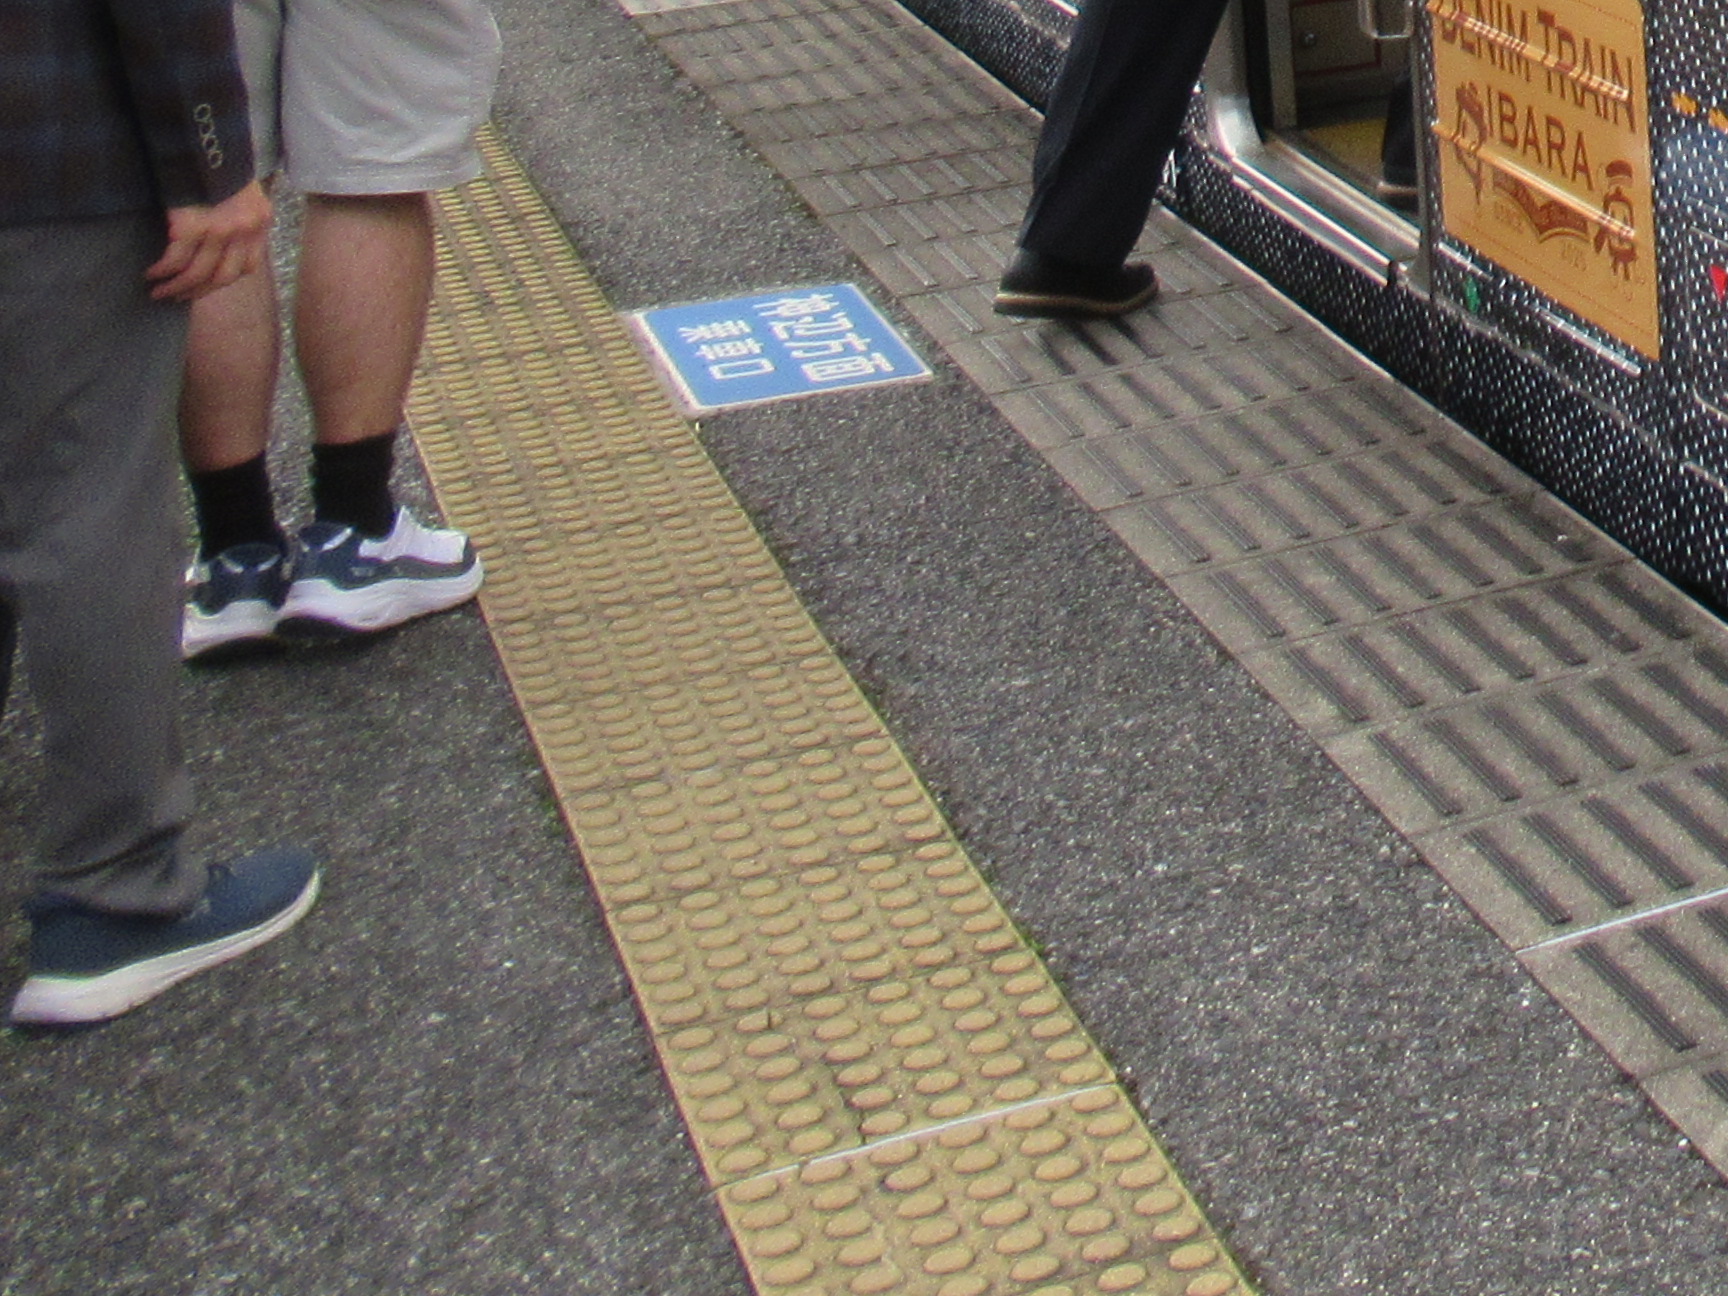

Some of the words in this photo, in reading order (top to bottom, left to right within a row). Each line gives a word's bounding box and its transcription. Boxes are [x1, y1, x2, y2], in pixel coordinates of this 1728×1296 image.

[1536, 7, 1638, 135] TRAIN
[1486, 84, 1594, 192] IBARA
[677, 319, 776, 381] 乗車口
[753, 292, 895, 384] 神辺方面
